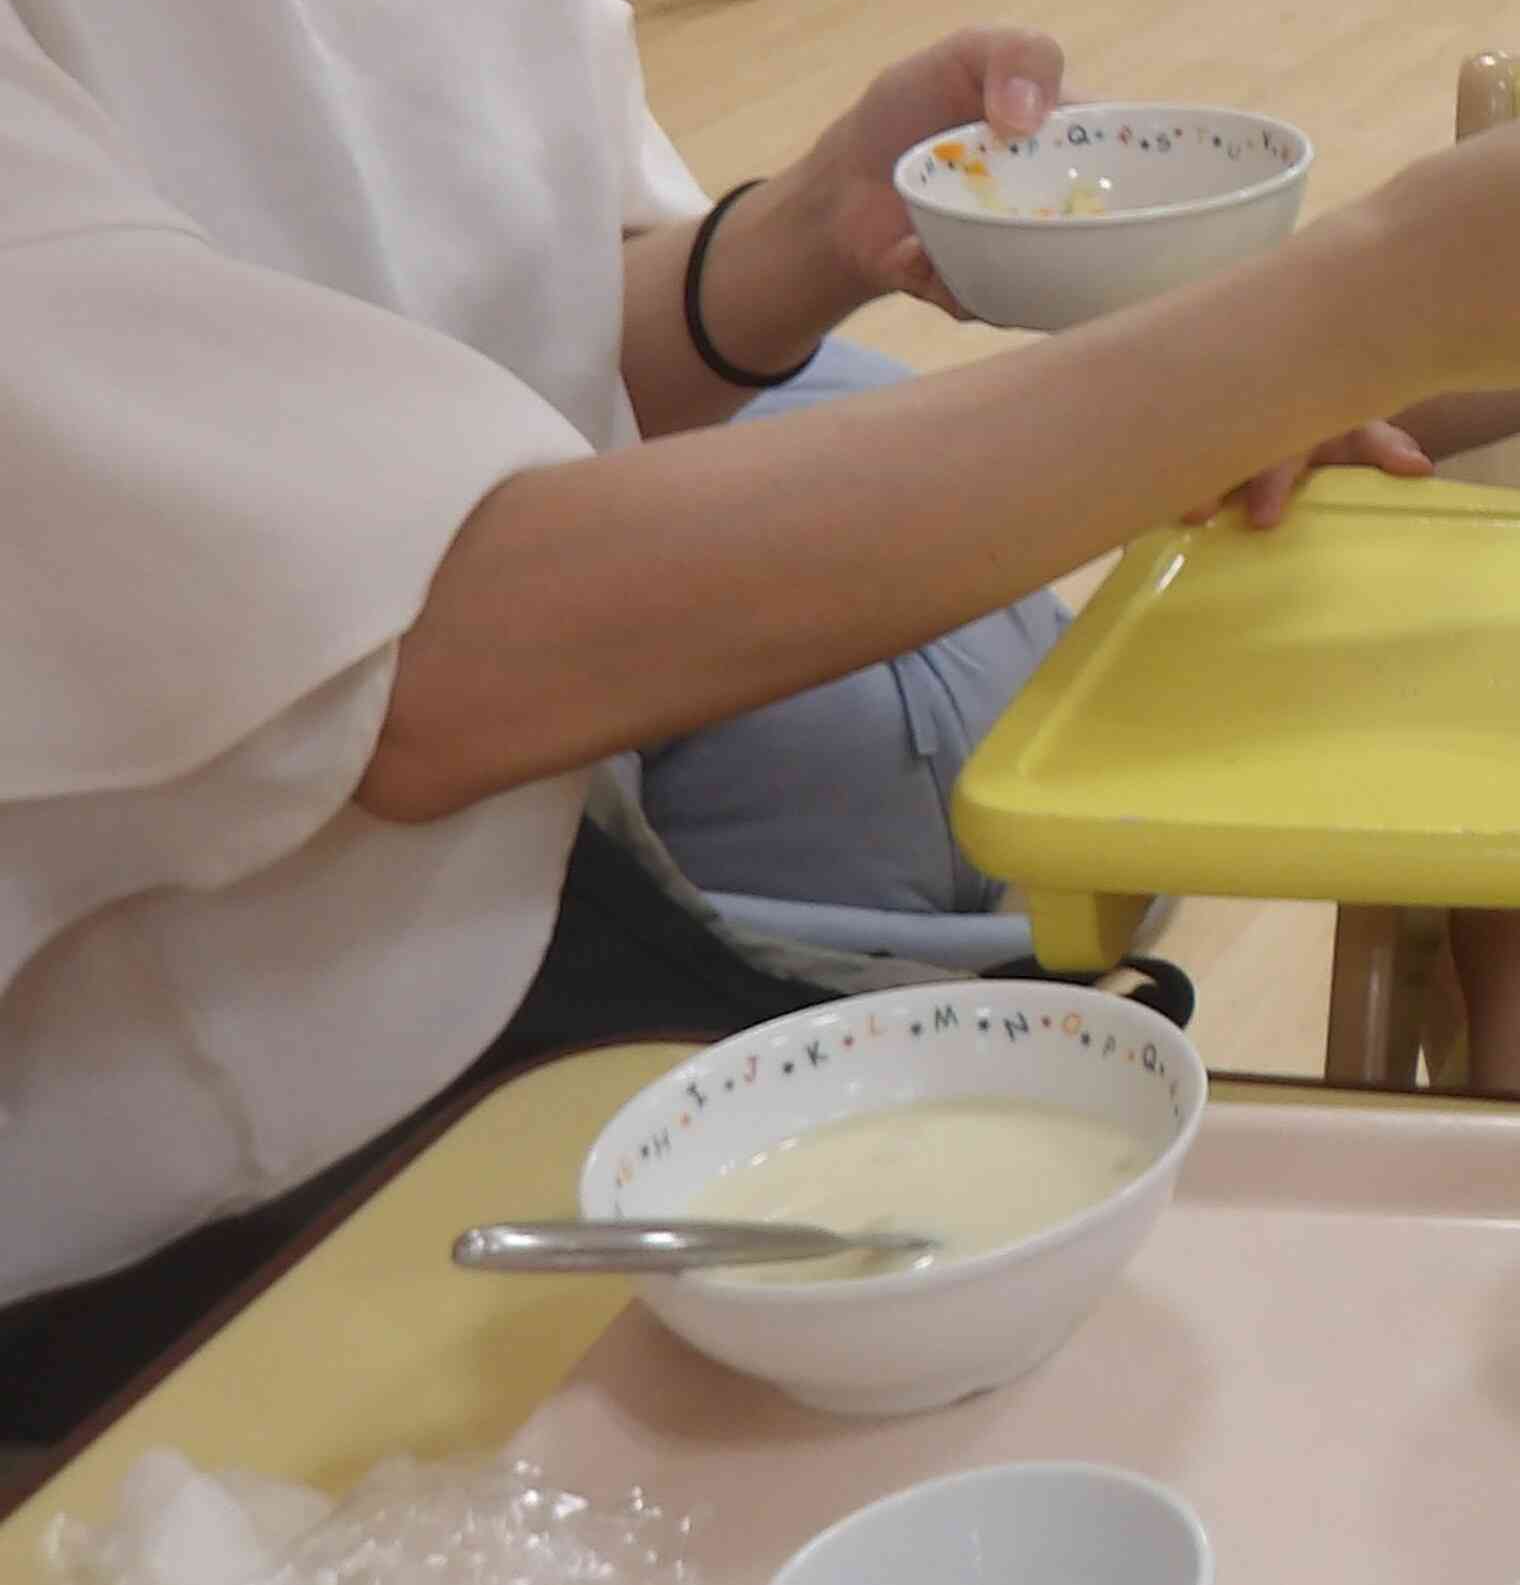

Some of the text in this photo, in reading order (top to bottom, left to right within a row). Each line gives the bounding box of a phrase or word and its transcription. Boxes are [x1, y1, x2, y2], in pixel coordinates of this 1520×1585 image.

[1067, 124, 1090, 145] Q
[744, 1053, 758, 1084] J
[806, 1040, 828, 1068] K
[869, 1013, 884, 1037] L
[933, 1004, 959, 1033] M
[1002, 1012, 1030, 1043] N
[1063, 1013, 1082, 1038] O
[1142, 1043, 1157, 1072] Q
